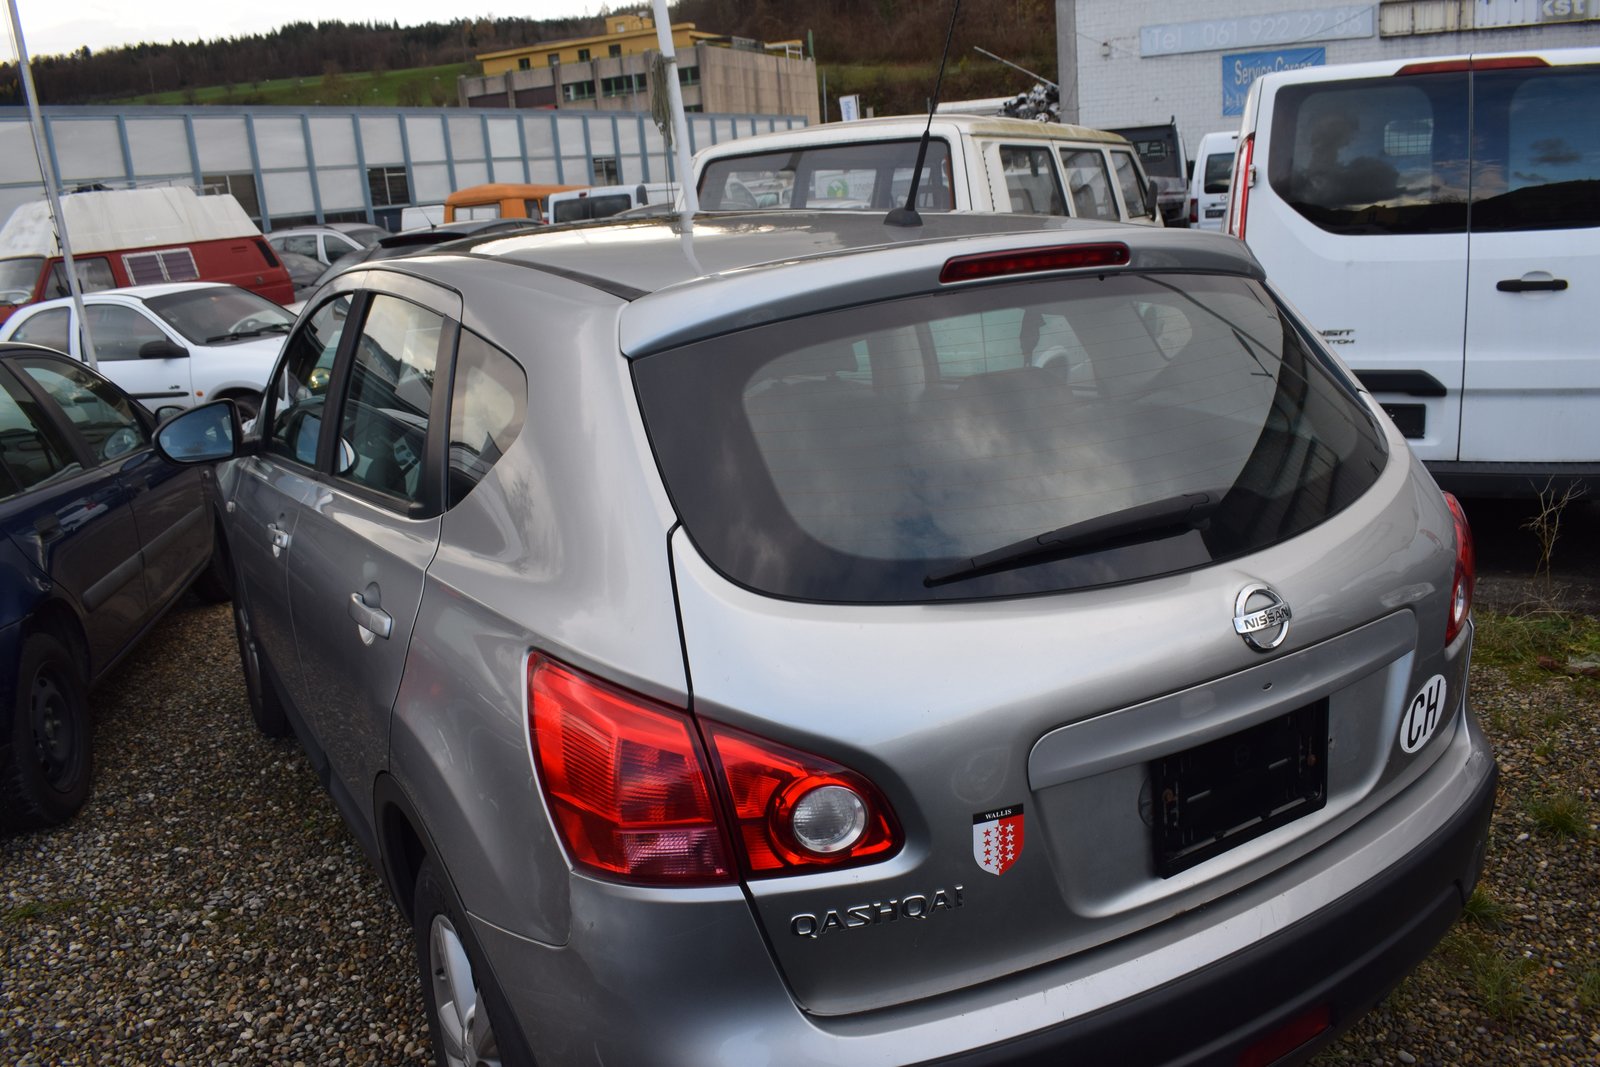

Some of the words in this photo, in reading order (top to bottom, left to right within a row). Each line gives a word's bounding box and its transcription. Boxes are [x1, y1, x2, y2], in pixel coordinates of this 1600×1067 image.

[1151, 28, 1181, 50] Tel
[1203, 23, 1238, 46] 061
[1249, 16, 1289, 41] 922
[1299, 13, 1324, 36] 22
[1335, 11, 1361, 35] 88
[1243, 606, 1289, 630] NISSAN
[1407, 678, 1442, 749] CH
[985, 808, 1012, 820] WALLIS
[790, 884, 964, 939] QASHQAI
